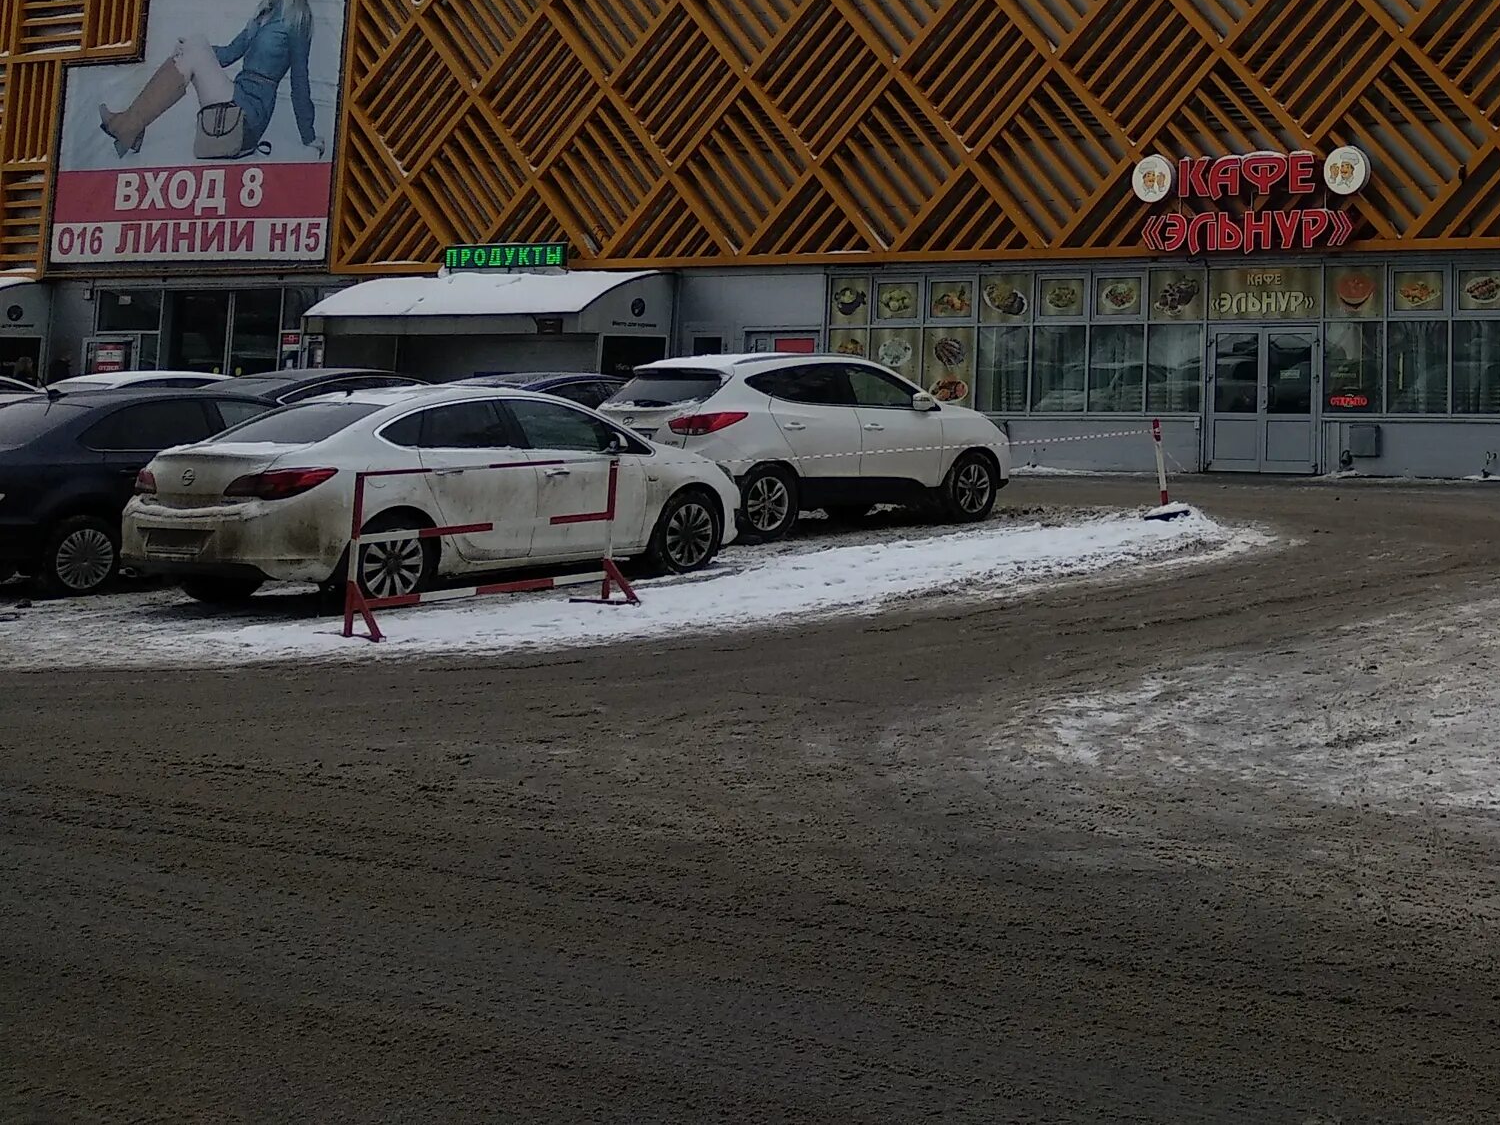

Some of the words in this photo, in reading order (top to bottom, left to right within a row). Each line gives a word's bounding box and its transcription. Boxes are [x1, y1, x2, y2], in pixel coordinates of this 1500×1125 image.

[114, 169, 226, 215] ВХОД
[239, 167, 264, 208] 8
[1178, 153, 1316, 201] КАФЕ
[58, 226, 103, 255] О16
[115, 221, 254, 254] ЛИНИИ
[269, 223, 320, 252] Н15
[1141, 209, 1353, 255] «ЭЛЬНУР»
[446, 246, 562, 267] ПРОДУКТЫ
[1247, 274, 1281, 286] КАФЕ
[1211, 291, 1315, 315] «ЭЛЬНУР»
